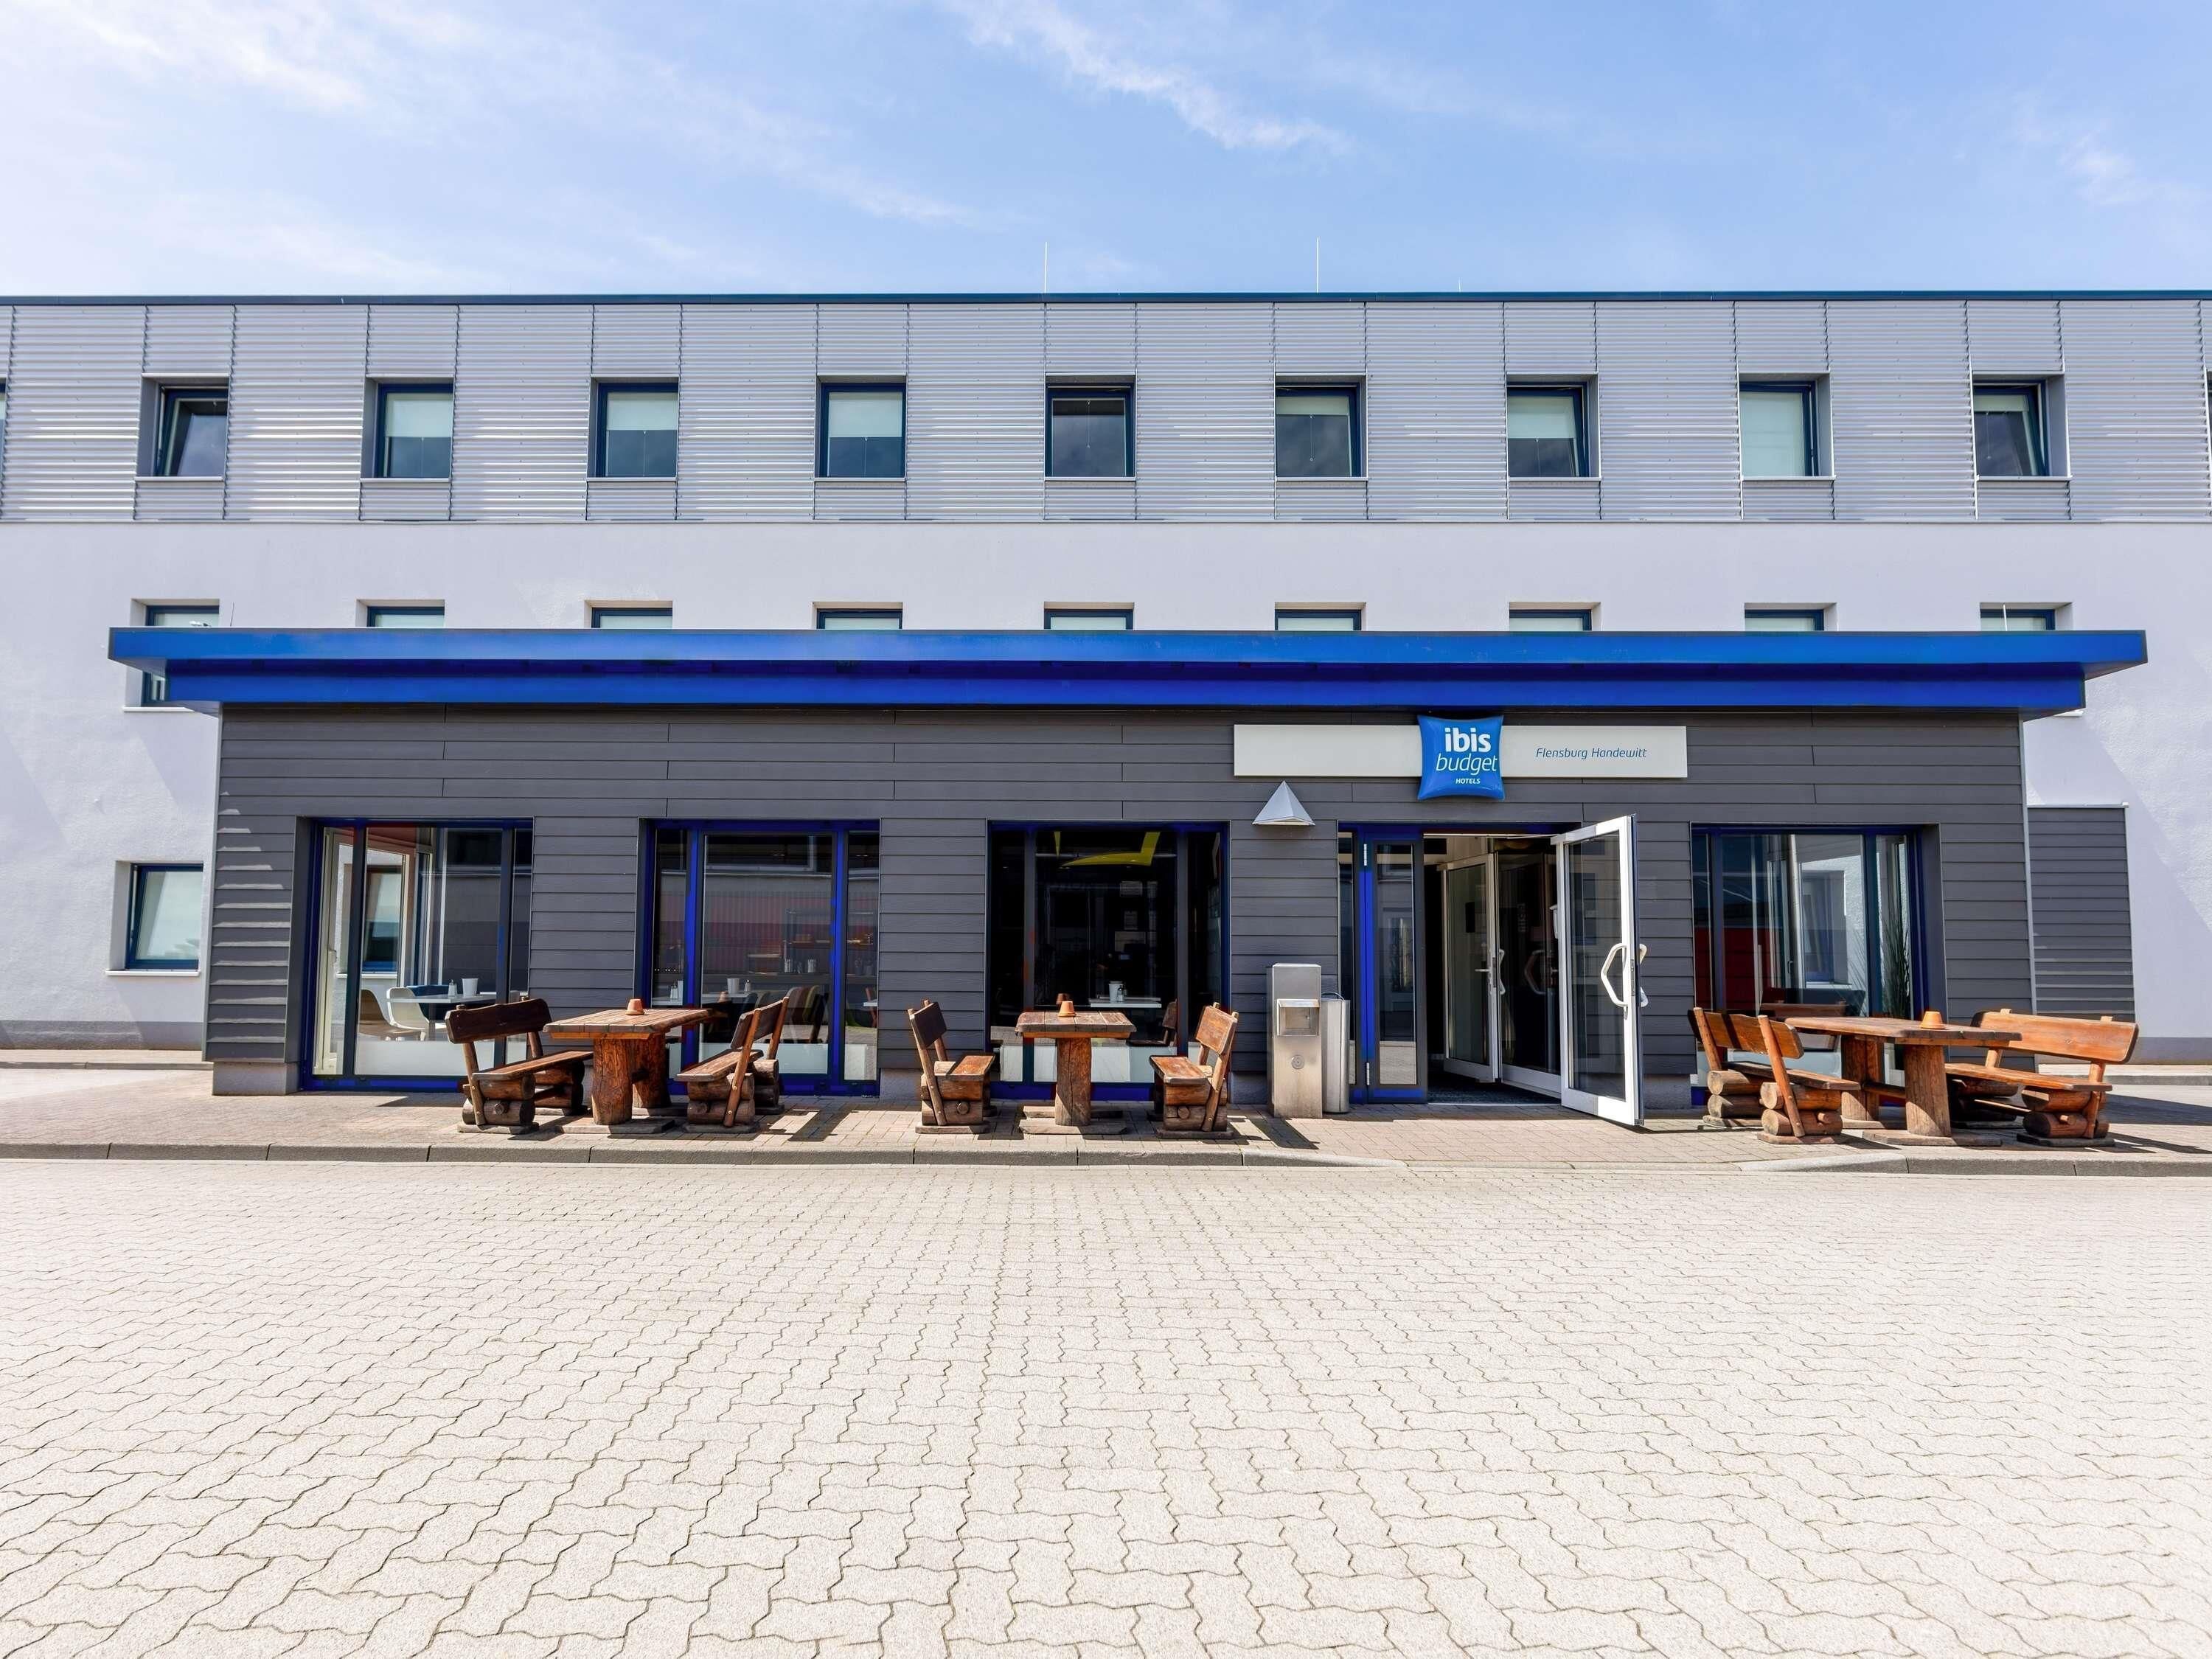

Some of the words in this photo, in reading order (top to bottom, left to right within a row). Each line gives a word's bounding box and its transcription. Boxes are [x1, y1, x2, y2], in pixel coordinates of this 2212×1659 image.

[1444, 727, 1491, 753] ibis
[1436, 753, 1498, 776] budget
[1536, 747, 1588, 759] Flensburg
[1591, 747, 1647, 758] Handewitt
